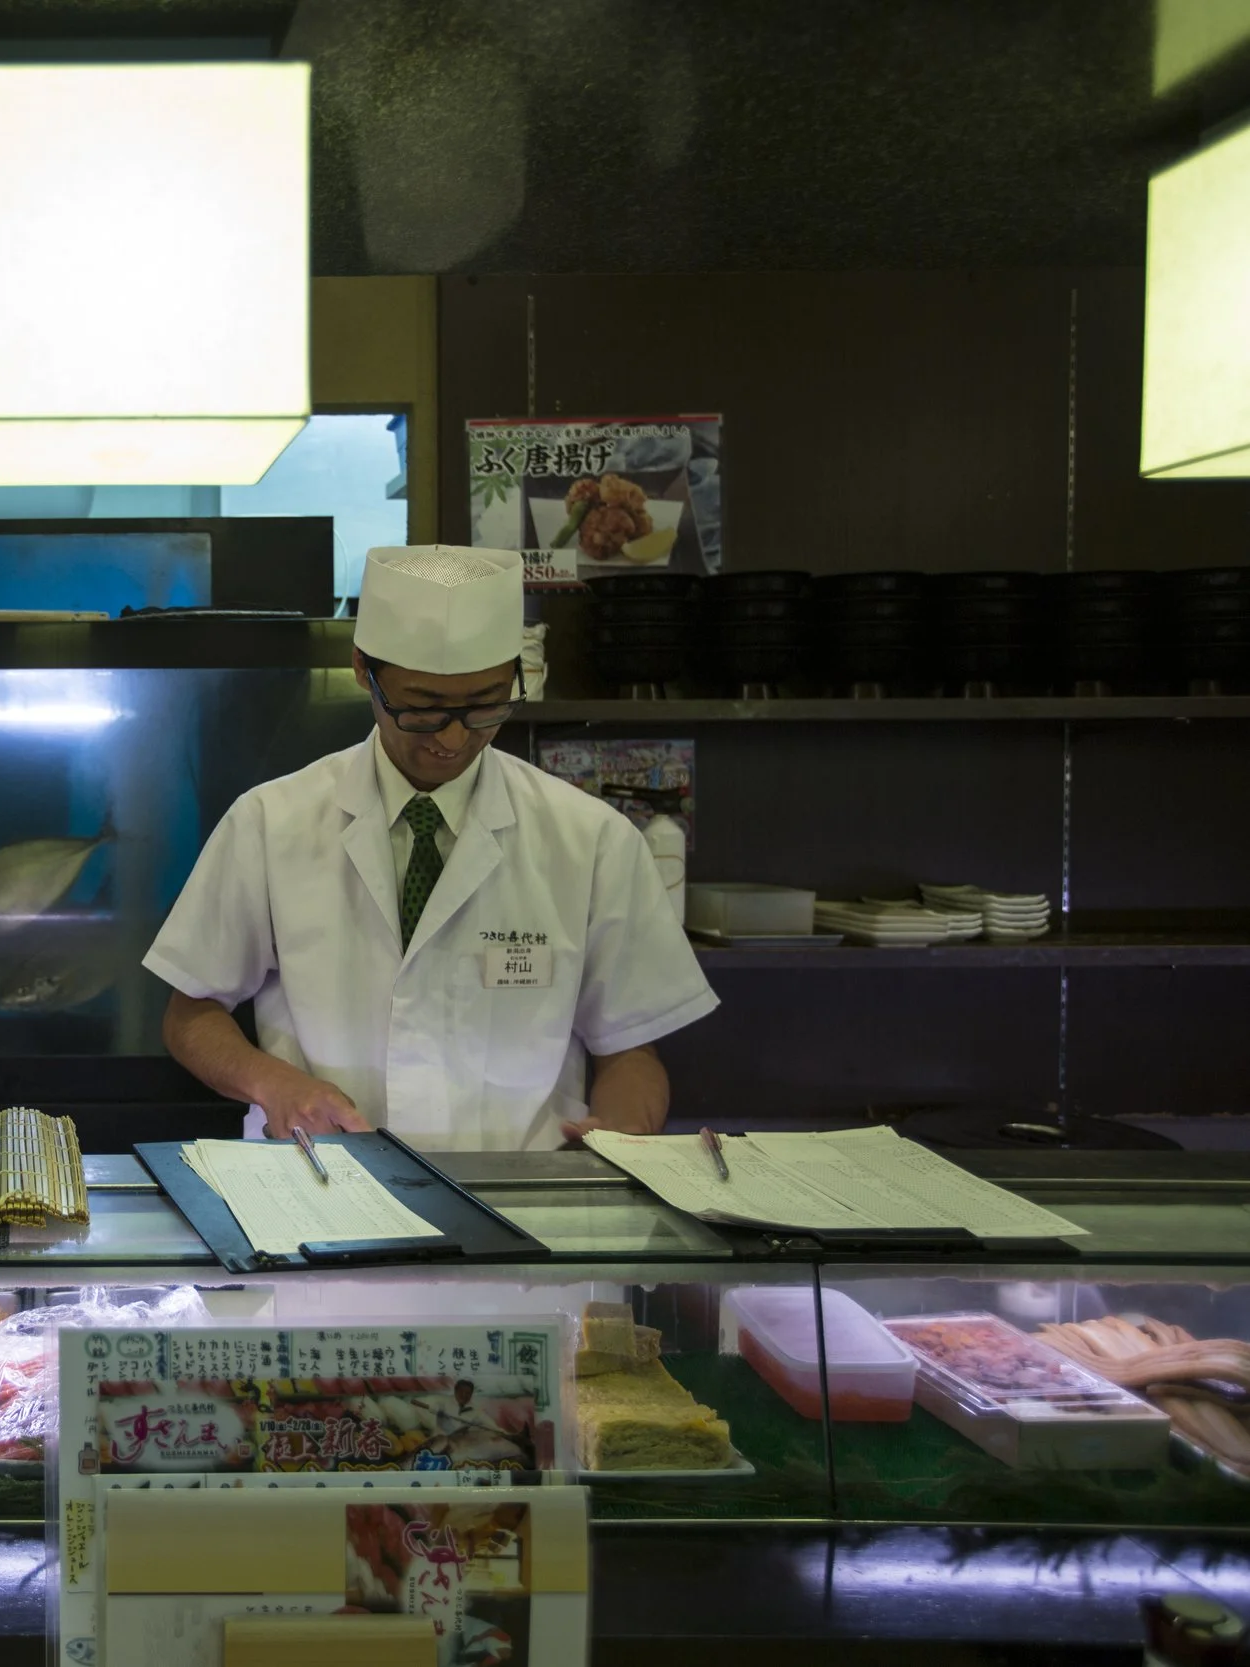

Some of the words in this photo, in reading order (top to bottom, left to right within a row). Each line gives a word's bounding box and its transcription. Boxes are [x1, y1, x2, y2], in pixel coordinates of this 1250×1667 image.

[475, 442, 615, 476] ふぐ唐揚げ
[479, 930, 548, 945] つきじ喜代村
[504, 960, 532, 974] 村山
